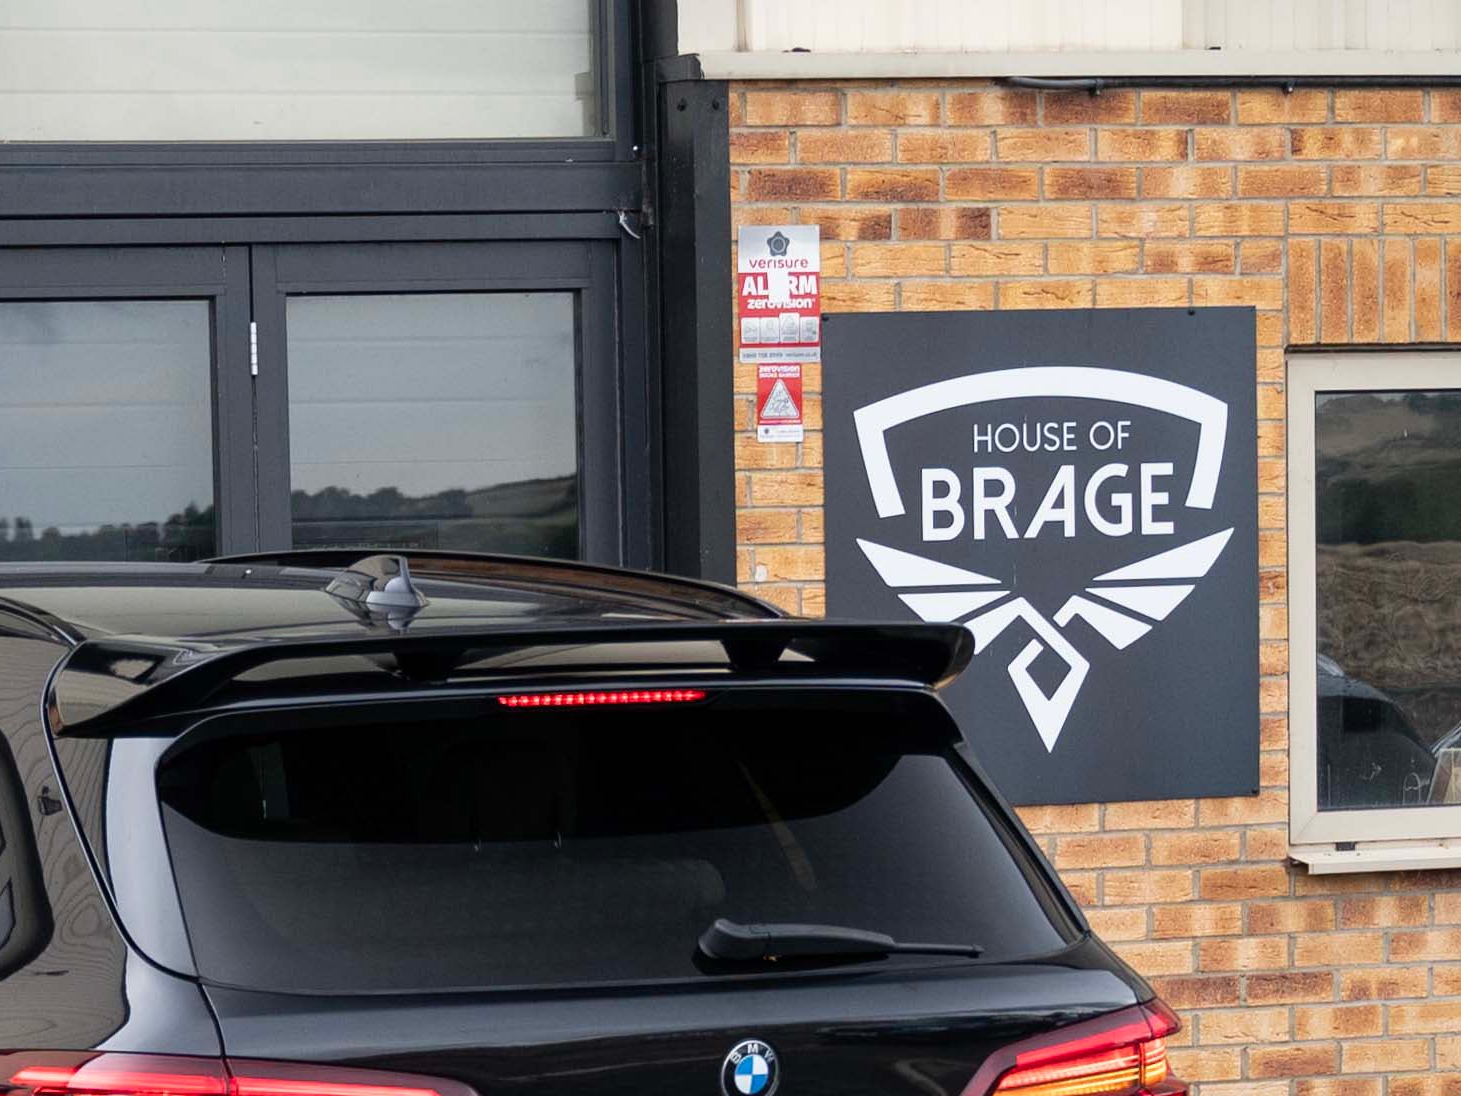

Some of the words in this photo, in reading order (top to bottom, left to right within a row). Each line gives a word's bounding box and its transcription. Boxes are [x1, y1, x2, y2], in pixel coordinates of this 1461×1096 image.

[749, 259, 809, 269] verisure
[742, 275, 817, 296] ALRM
[972, 421, 1078, 453] HOUSE
[1089, 420, 1132, 452] OF
[921, 462, 1175, 542] BRAGE
